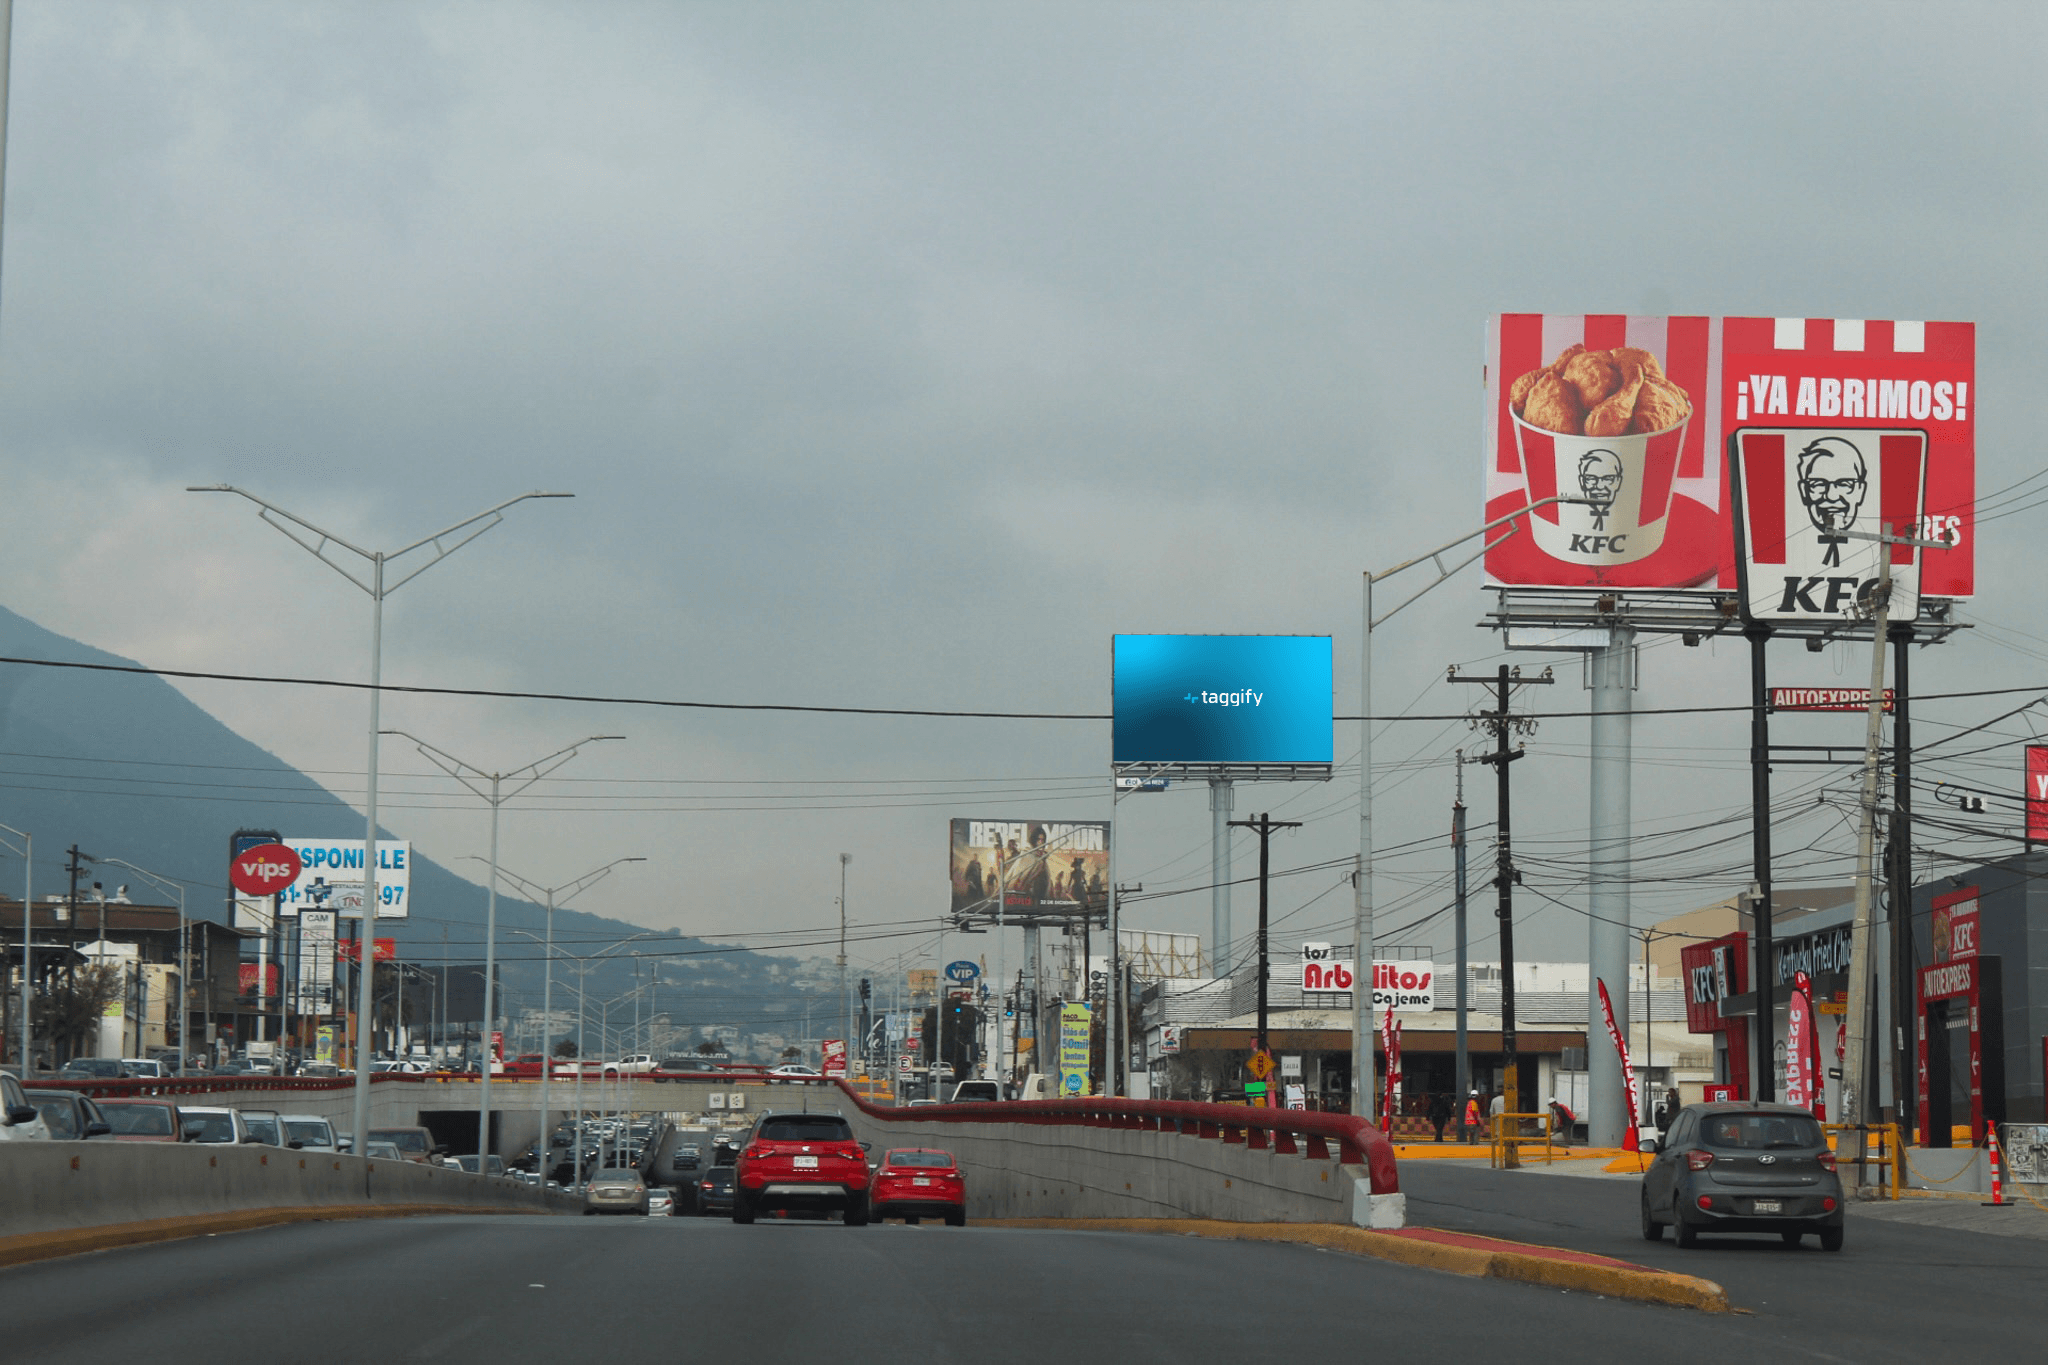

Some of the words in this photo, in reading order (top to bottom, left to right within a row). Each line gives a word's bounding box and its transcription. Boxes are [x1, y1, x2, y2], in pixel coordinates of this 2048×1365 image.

[1737, 374, 1788, 420] ¡YA
[1795, 376, 1968, 421] ABRIMOS!
[1569, 533, 1627, 554] KFC
[1202, 689, 1263, 707] taggify
[1774, 689, 1891, 708] AUTOEXPRES
[969, 821, 1028, 848] REBEL
[241, 856, 290, 883] vips
[295, 847, 405, 870] SPONILE
[307, 914, 329, 923] CAM
[1953, 921, 1974, 952] KFC
[951, 969, 974, 979] VIP
[1304, 963, 1431, 990] Arblitos
[1692, 965, 1716, 1004] KFC
[1924, 963, 1972, 998] AUTOEXPRESS
[1372, 992, 1430, 1008] Cajeme
